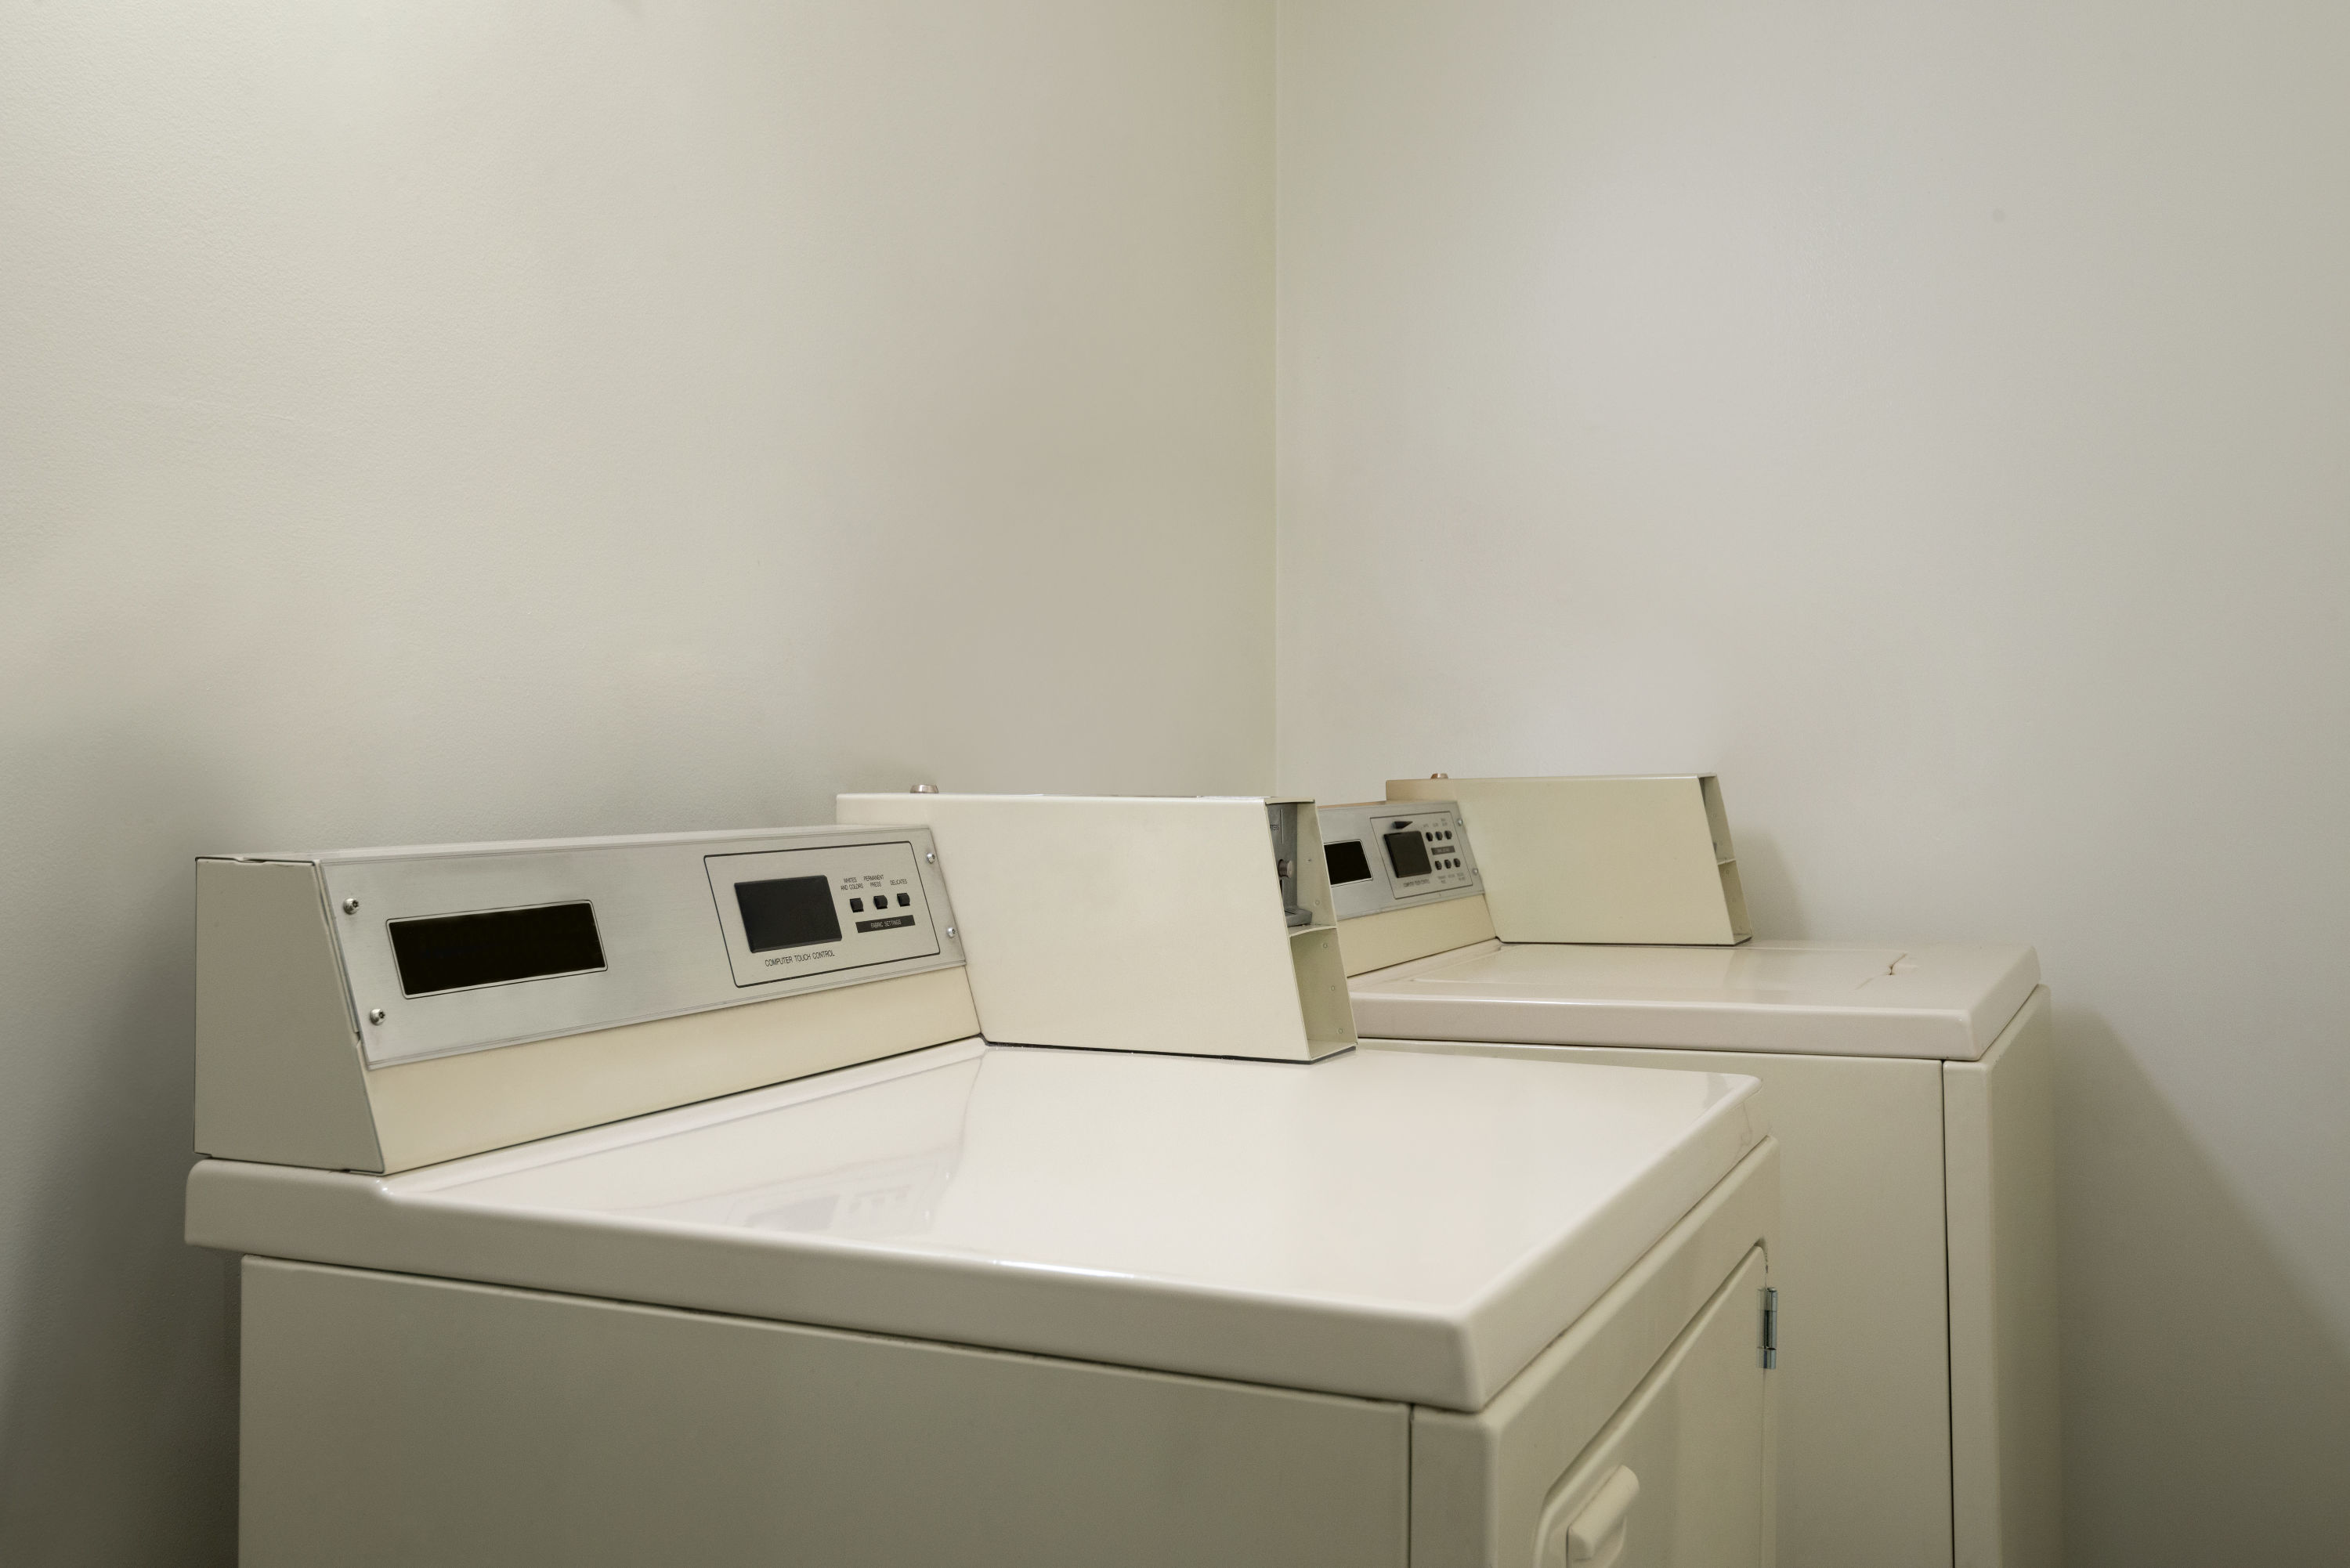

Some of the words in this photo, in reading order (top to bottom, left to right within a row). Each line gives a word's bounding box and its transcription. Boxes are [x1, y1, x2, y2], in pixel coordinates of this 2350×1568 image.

[765, 956, 794, 966] COMPUTER
[794, 953, 812, 963] TOUCH
[812, 949, 835, 959] CONTROL
